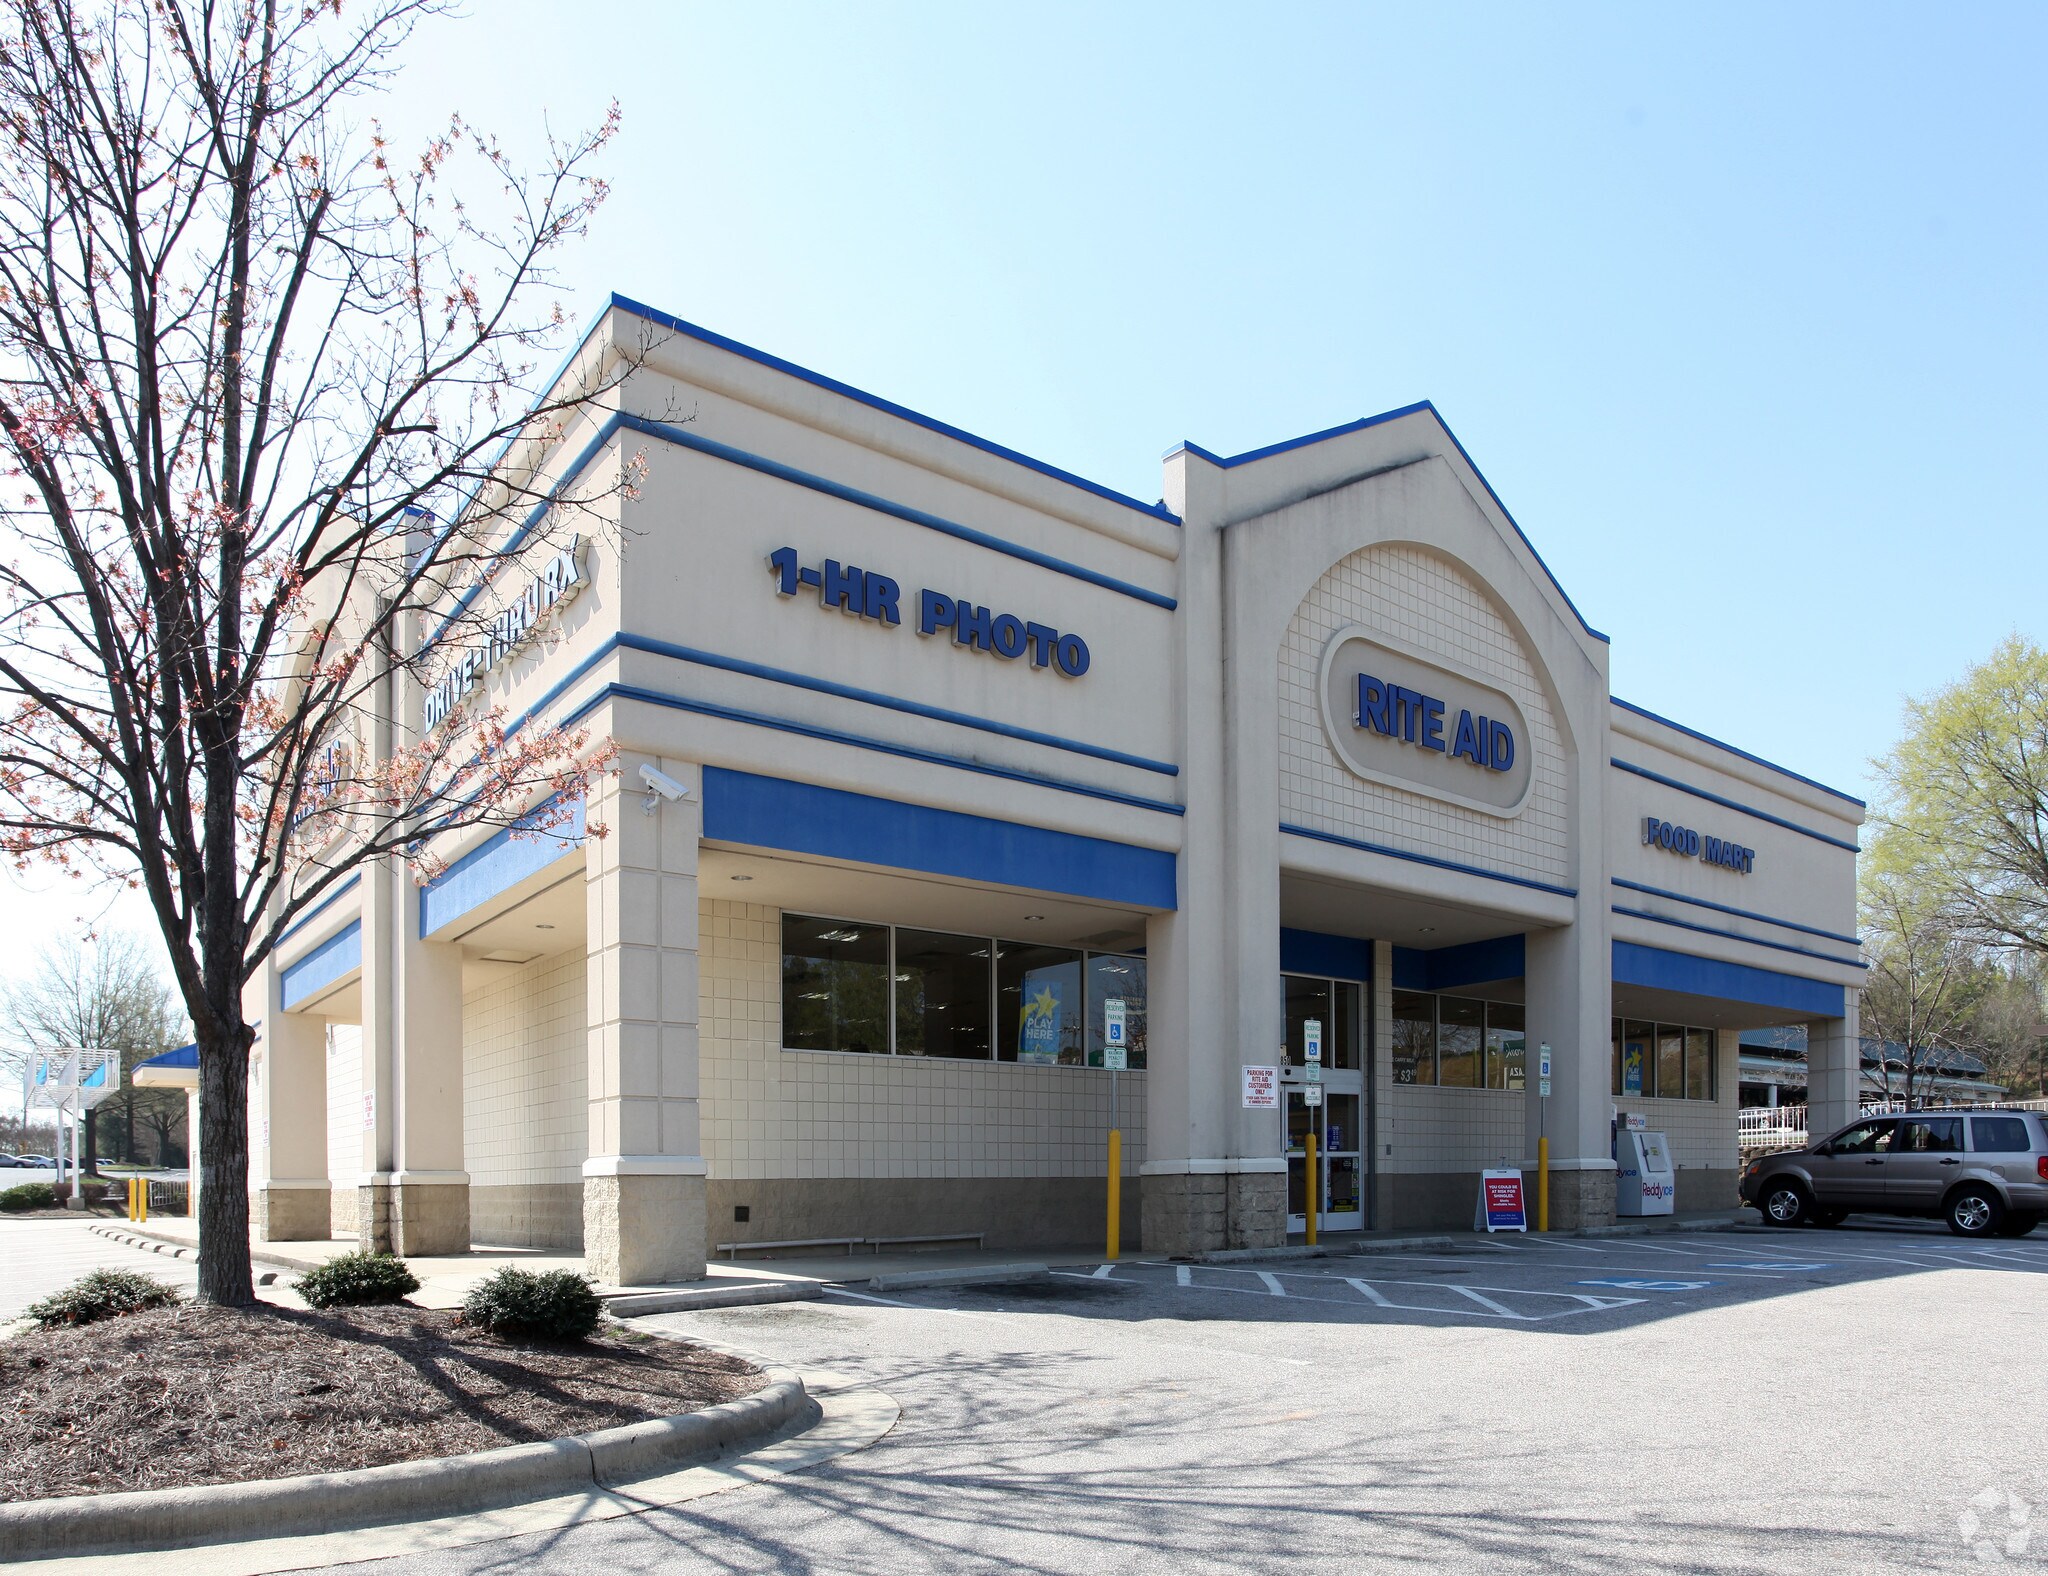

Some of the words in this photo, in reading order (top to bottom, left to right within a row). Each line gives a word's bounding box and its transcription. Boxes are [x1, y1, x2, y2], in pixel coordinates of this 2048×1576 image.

[767, 546, 900, 627] 1-HR
[918, 588, 1091, 677] PHOTO
[1355, 672, 1445, 752] RITE
[1451, 709, 1515, 772] AID
[1645, 817, 1699, 857] FOOD
[1702, 835, 1755, 874] MART
[1026, 1028, 1053, 1040] HERE
[1027, 1017, 1053, 1029] PLAY
